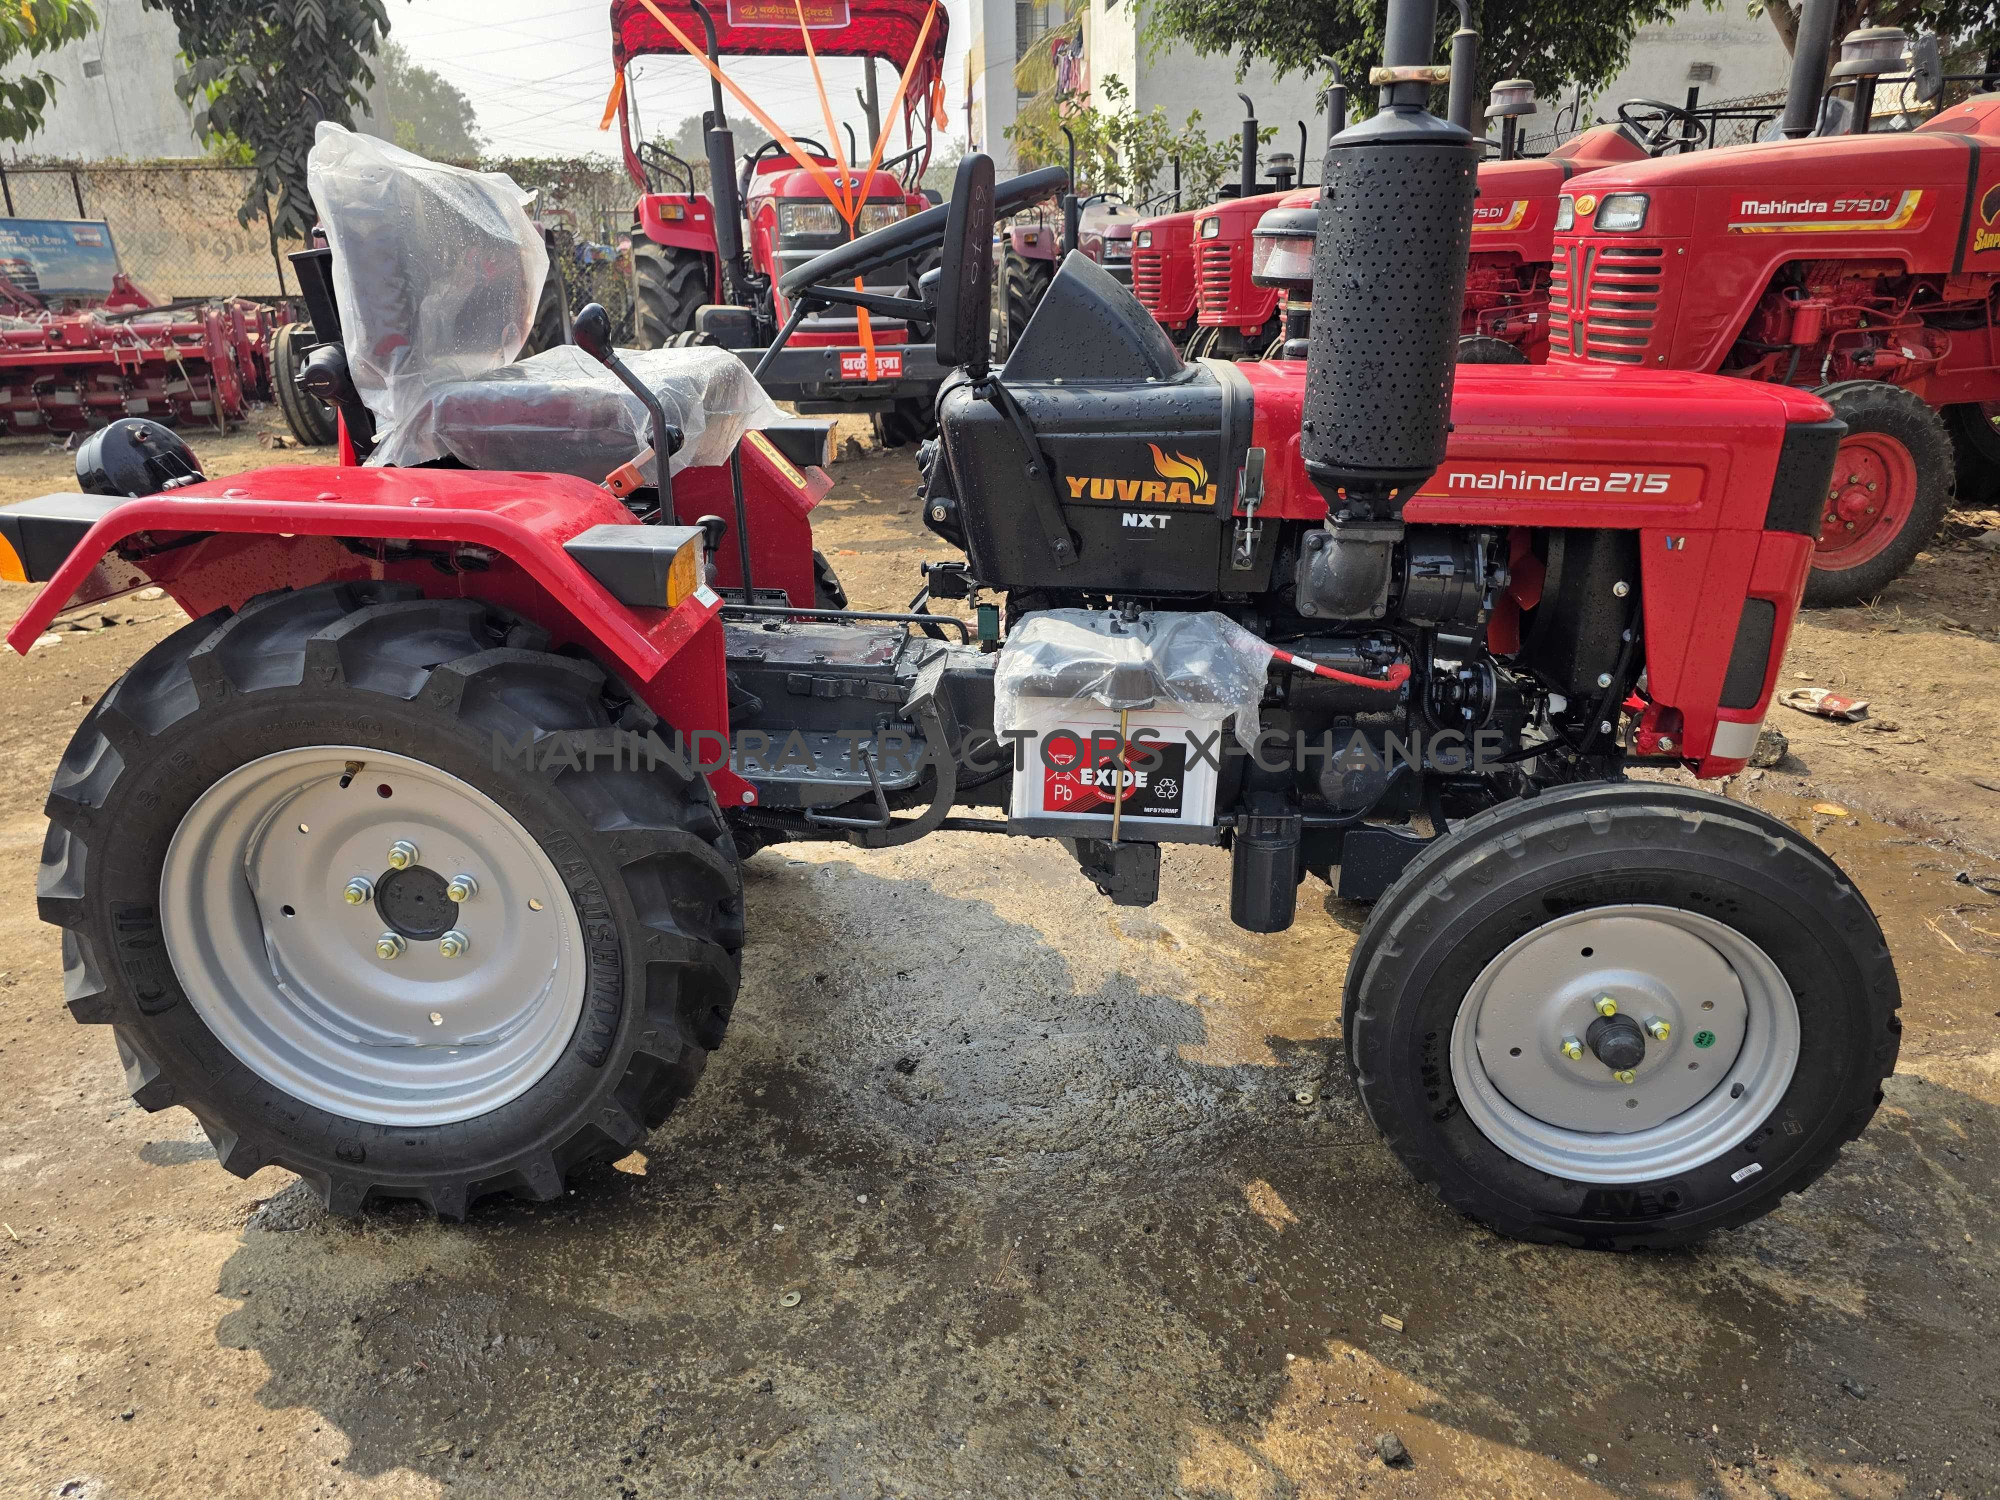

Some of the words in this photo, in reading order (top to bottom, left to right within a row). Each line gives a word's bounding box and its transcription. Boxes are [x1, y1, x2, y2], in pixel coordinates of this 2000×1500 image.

[1473, 208, 1504, 218] 75DI
[1740, 200, 1828, 214] Mahindra
[1832, 198, 1891, 213] 575DI
[1973, 228, 2000, 252] SARP
[1066, 476, 1217, 505] YUVRAJ
[1449, 469, 1600, 492] mahindra
[1604, 472, 1671, 494] 215
[1122, 513, 1171, 529] NXT
[1080, 768, 1149, 788] EXIDE
[1054, 784, 1073, 801] Pb
